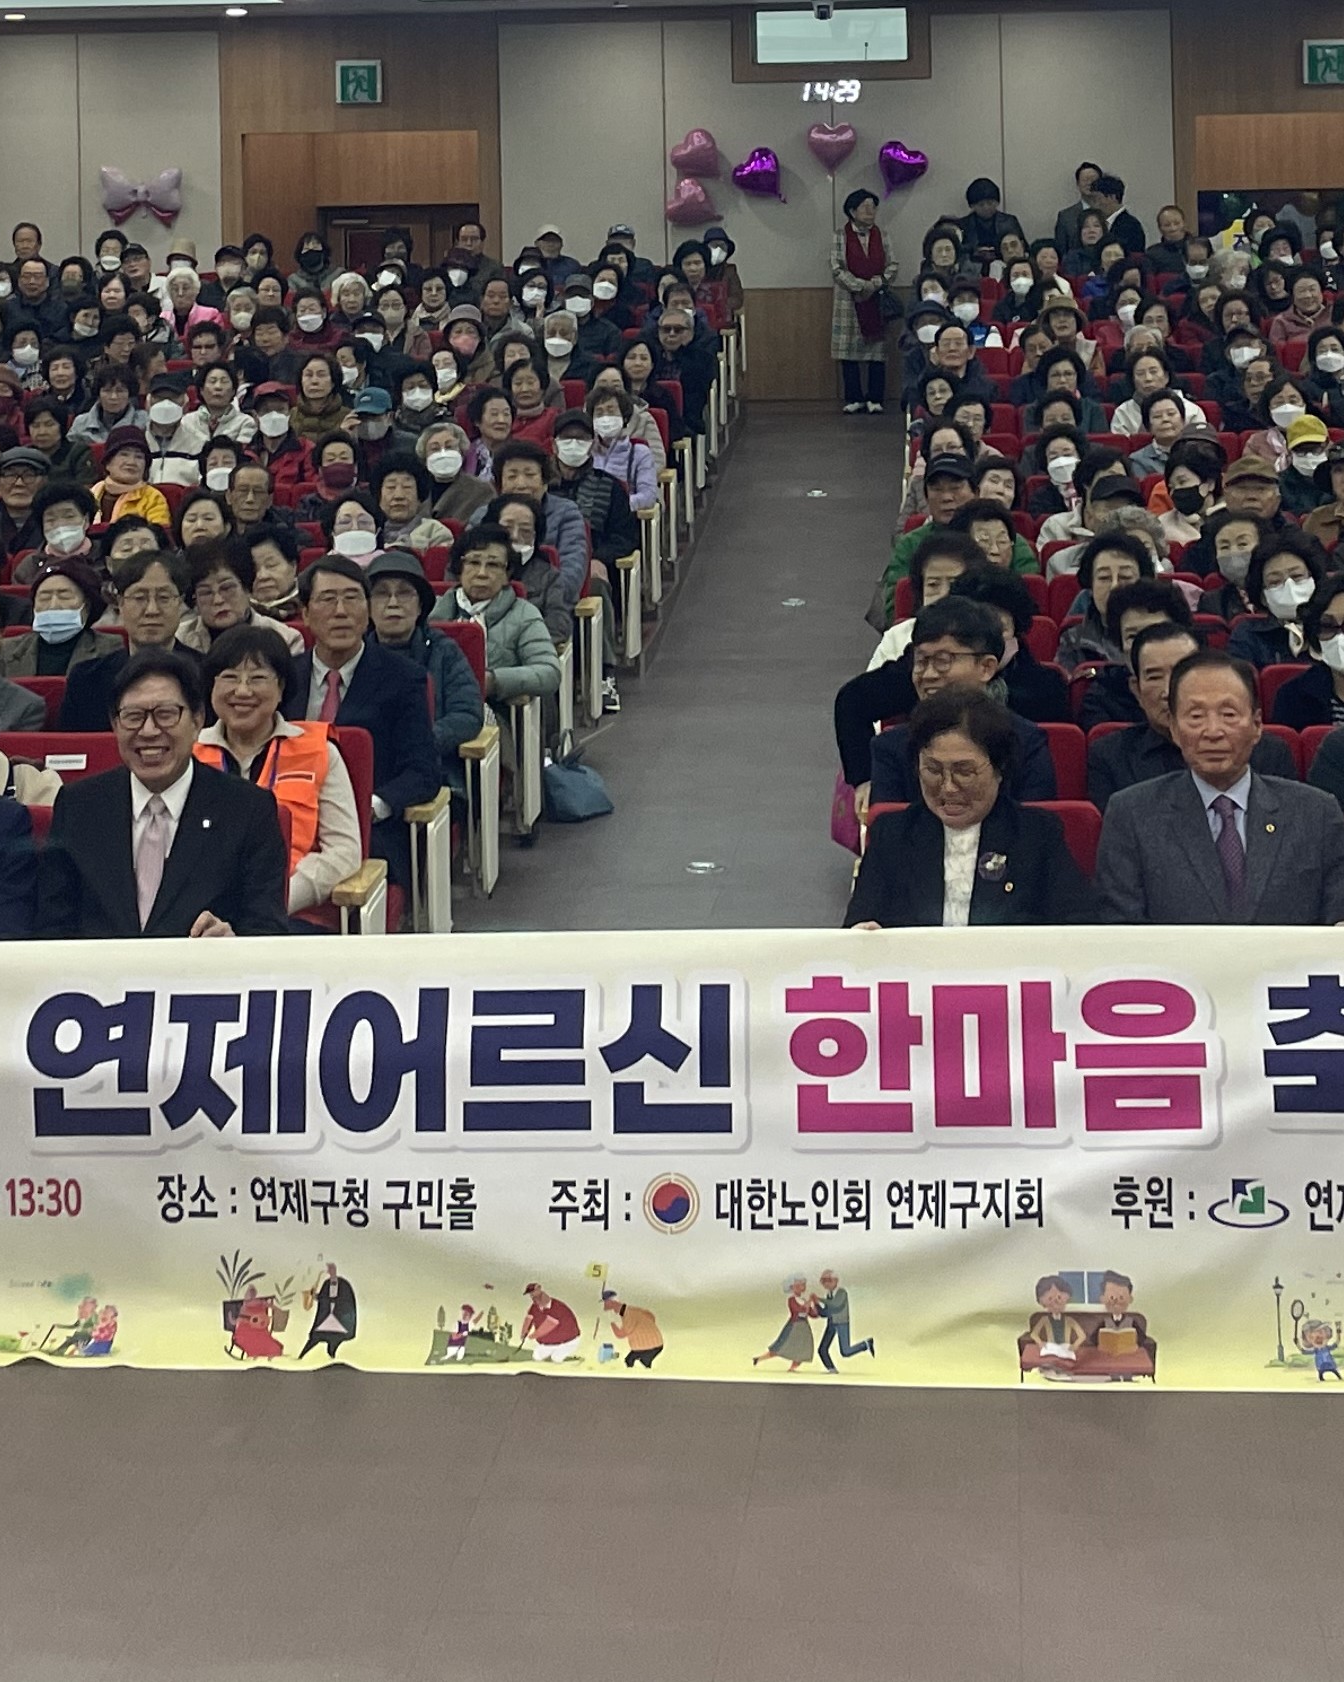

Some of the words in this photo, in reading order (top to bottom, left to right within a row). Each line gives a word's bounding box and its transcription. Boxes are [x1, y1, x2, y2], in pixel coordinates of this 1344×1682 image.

[26, 984, 733, 1138] 연제어르신
[785, 976, 1207, 1134] 한마음
[5, 1177, 82, 1217] 13:30
[156, 1173, 219, 1224] 장소
[250, 1176, 370, 1228] 연제구청
[382, 1177, 477, 1231] 구민홀
[548, 1178, 610, 1231] 주최
[715, 1178, 871, 1231] 대한노인회
[886, 1177, 1044, 1230] 연제구지회
[1111, 1176, 1174, 1230] 후원
[592, 1264, 602, 1277] 5
